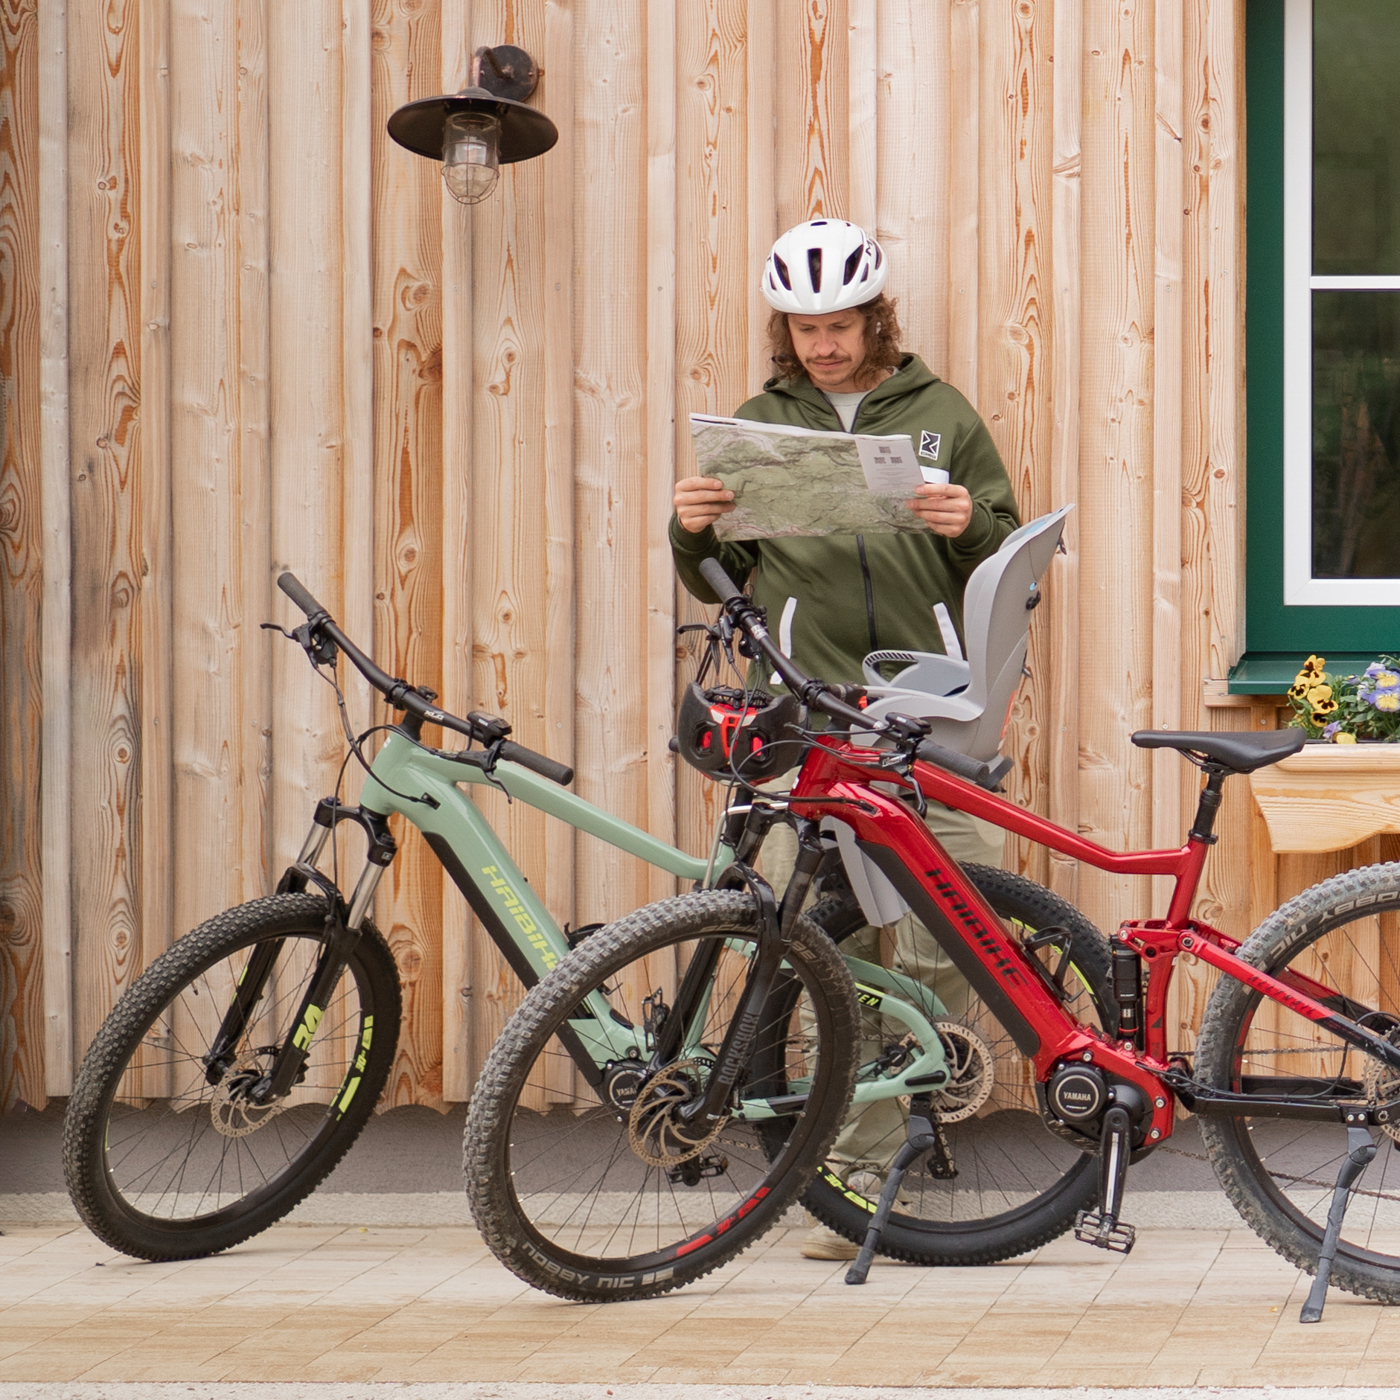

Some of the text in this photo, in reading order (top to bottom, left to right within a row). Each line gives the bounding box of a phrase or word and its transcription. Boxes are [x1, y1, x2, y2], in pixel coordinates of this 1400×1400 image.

[924, 868, 1029, 989] HAIBIKE
[717, 1011, 760, 1086] ROCKSHOX
[1063, 1091, 1092, 1101] YAMAHA
